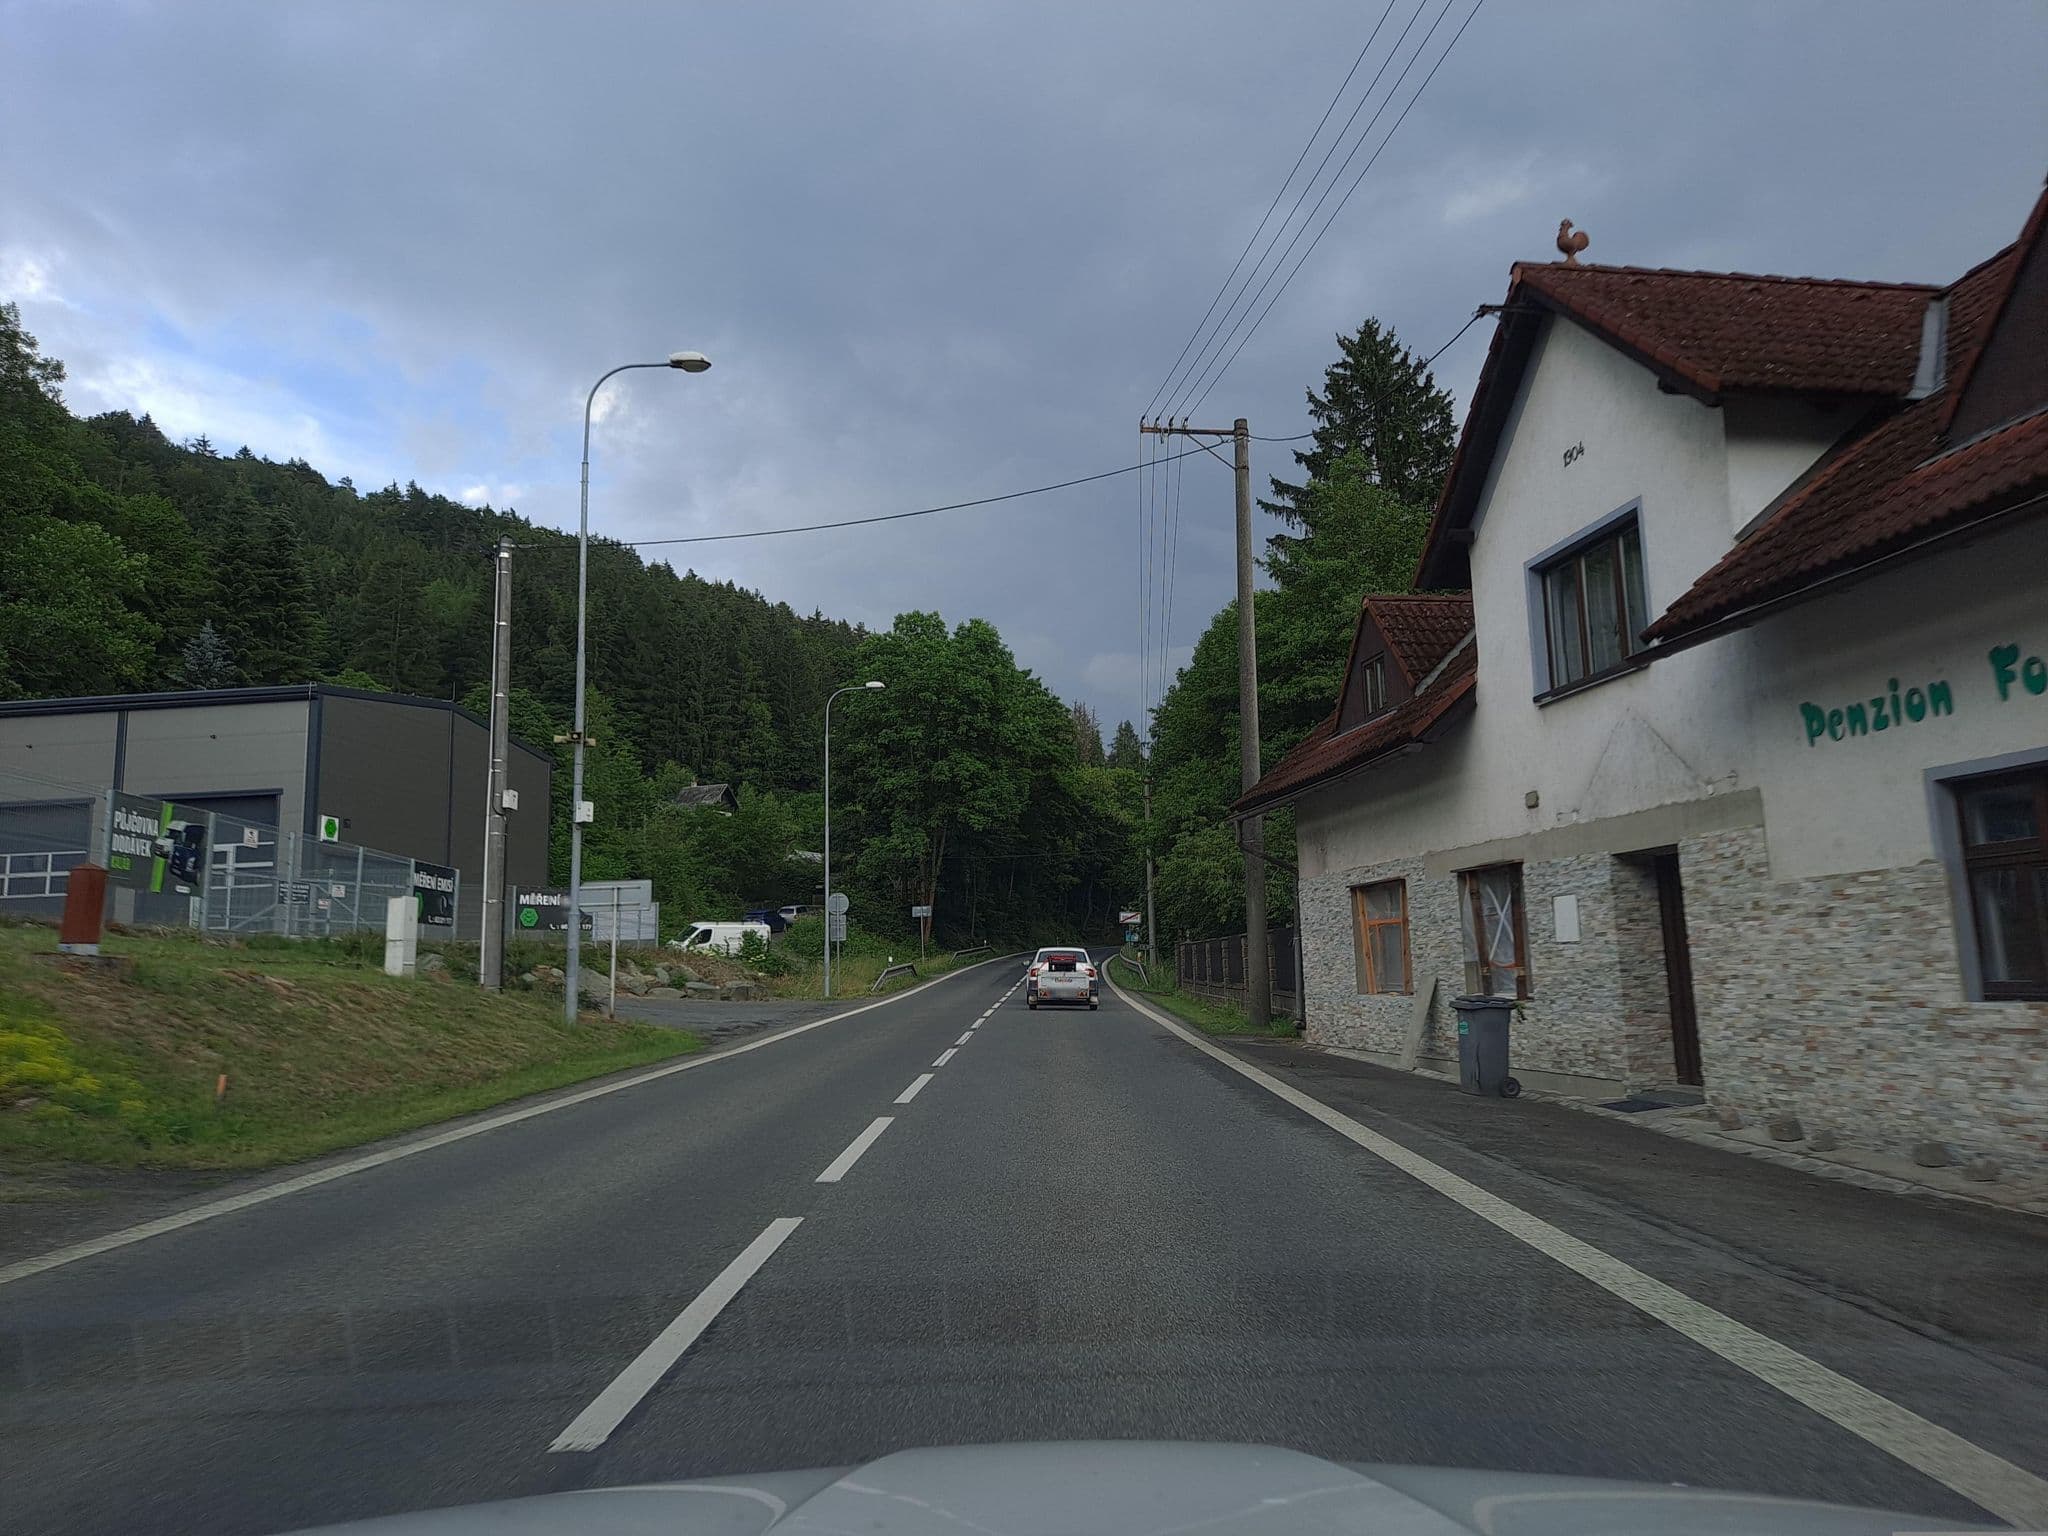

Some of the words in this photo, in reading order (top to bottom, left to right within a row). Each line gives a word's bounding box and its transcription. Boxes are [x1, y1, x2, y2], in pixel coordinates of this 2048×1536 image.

[1800, 677, 1954, 748] Penzion
[111, 832, 152, 858] DODÁVEK
[519, 892, 561, 906] MĚŘENÍ
